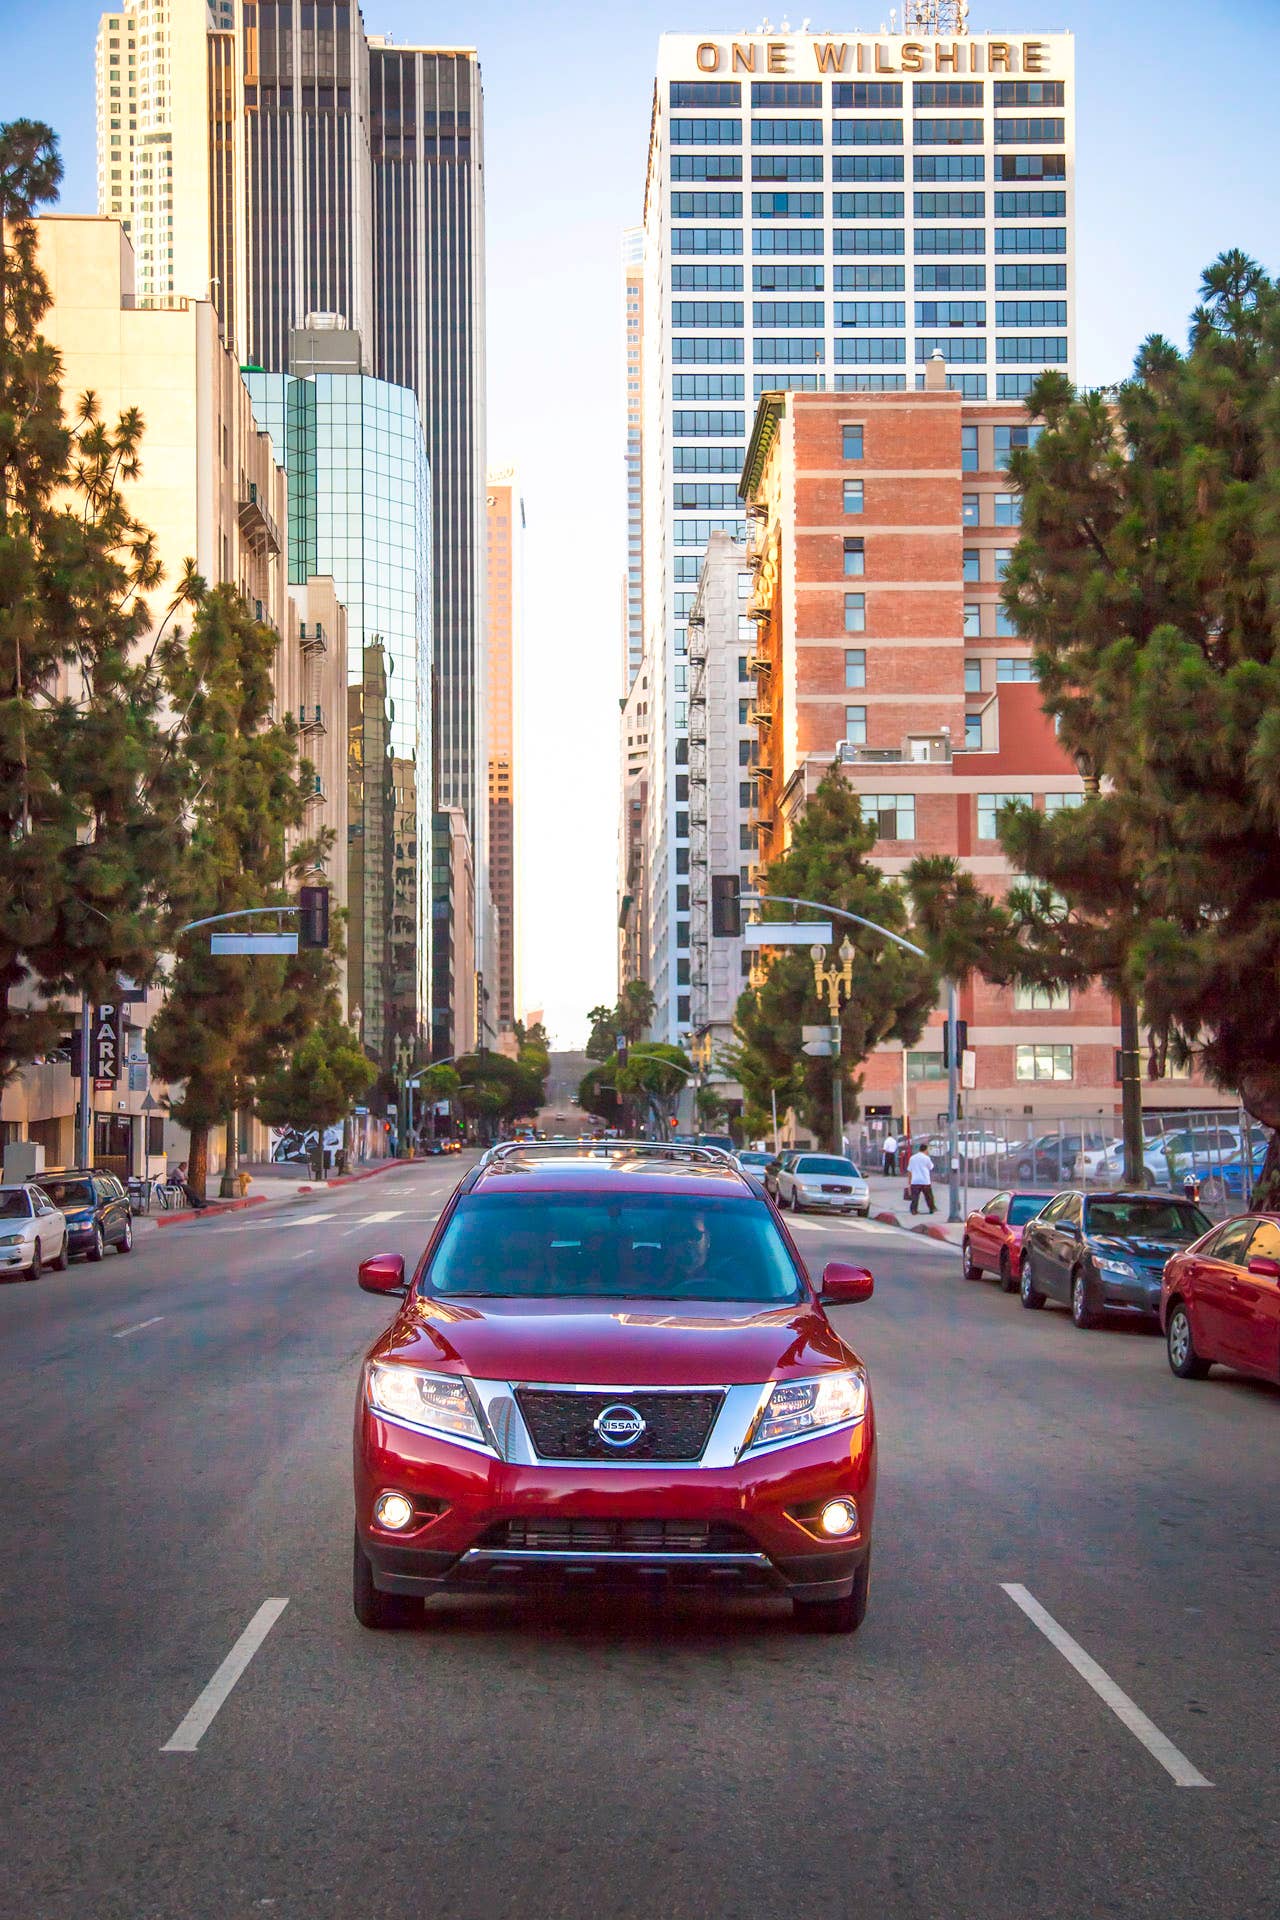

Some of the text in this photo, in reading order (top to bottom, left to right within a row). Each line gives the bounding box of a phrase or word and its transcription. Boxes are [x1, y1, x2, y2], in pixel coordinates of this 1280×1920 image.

[696, 42, 1042, 73] ONE WILSHIRE
[96, 1004, 117, 1077] PARK
[600, 1422, 640, 1430] NISSAN
